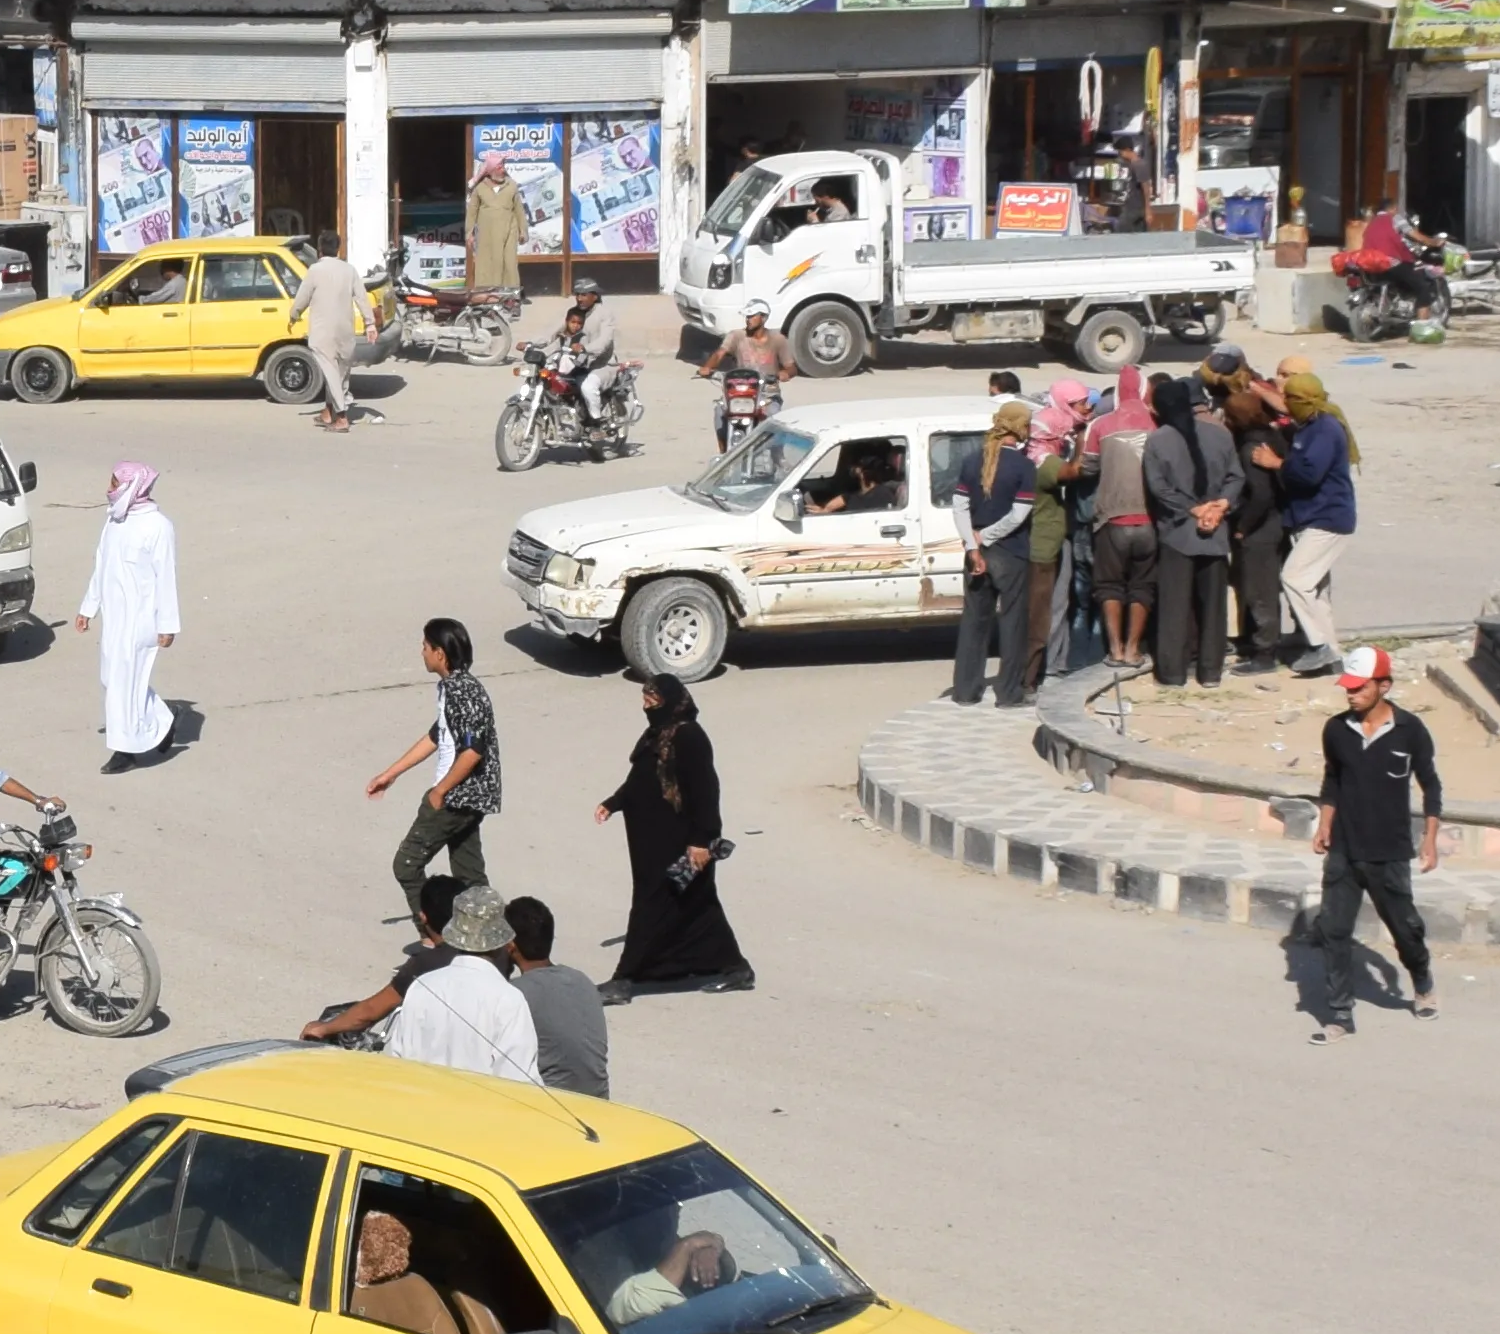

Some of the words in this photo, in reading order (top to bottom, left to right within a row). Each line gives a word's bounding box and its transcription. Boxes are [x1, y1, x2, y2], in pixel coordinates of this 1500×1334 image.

[185, 124, 226, 148] الوليد
[227, 121, 251, 150] أبو
[480, 125, 527, 146] الوليد
[528, 123, 554, 145] أبو
[1004, 189, 1068, 207] الزعيم
